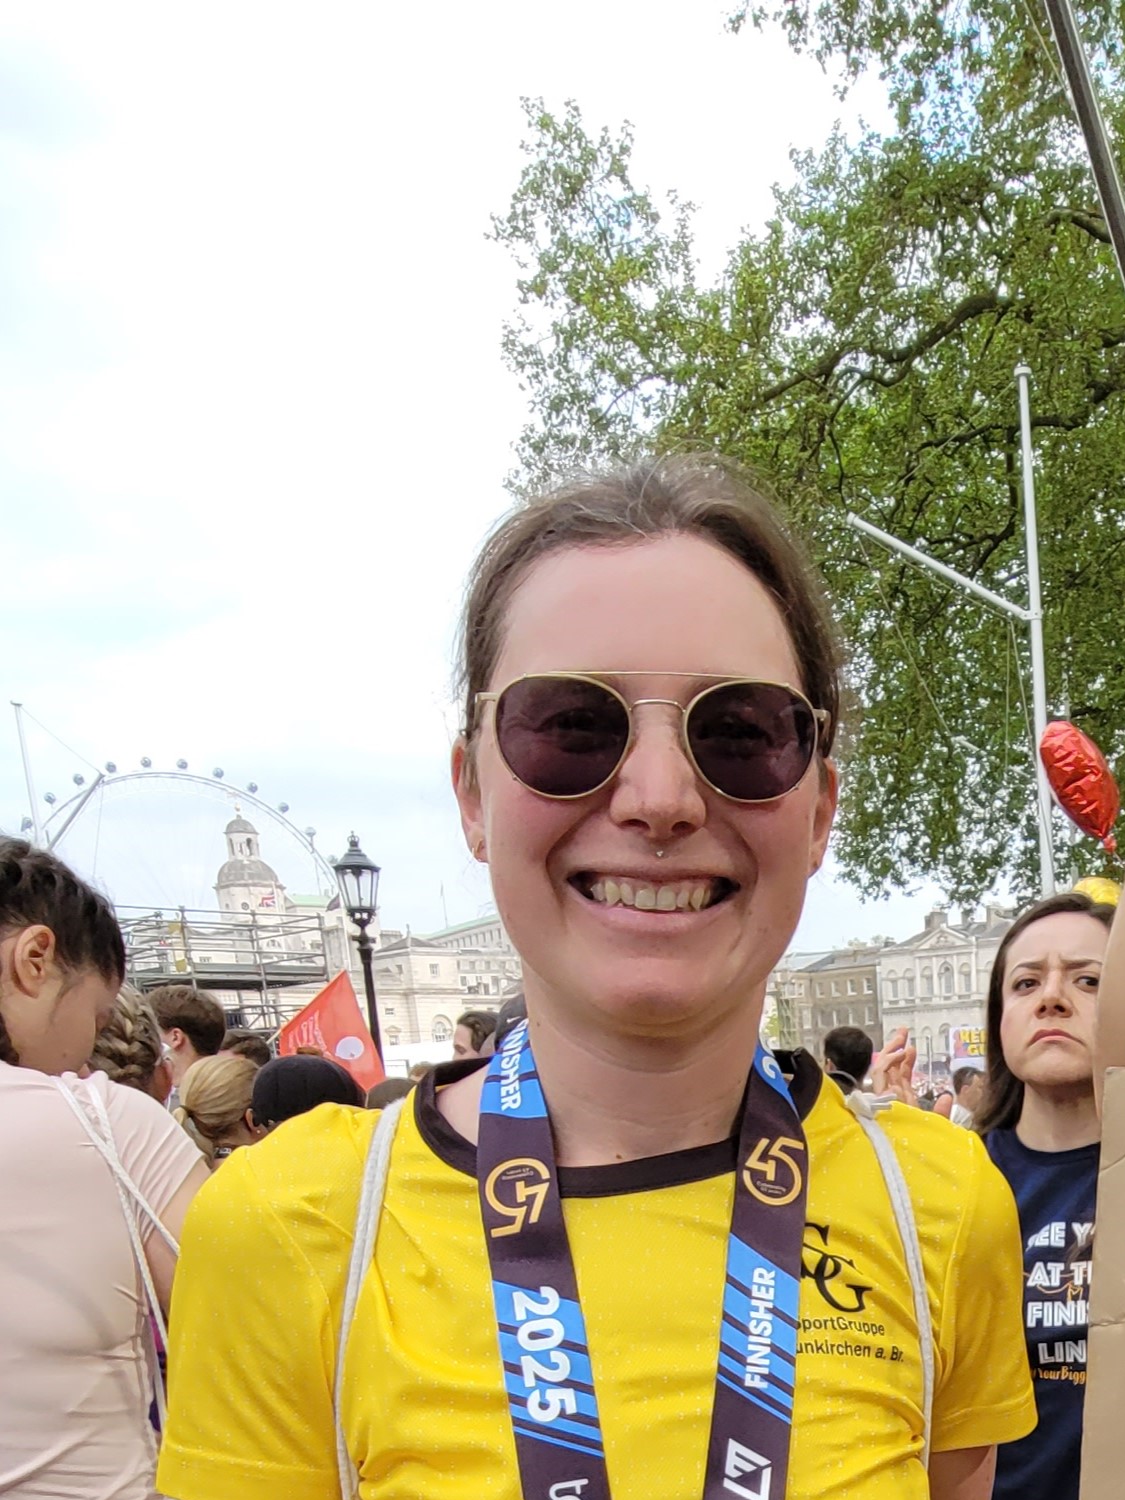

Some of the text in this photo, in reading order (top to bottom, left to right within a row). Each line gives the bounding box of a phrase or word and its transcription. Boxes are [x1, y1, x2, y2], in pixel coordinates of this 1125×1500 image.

[1026, 1261, 1065, 1287] AT
[744, 1267, 775, 1389] FINISHER
[1026, 1300, 1090, 1328] FINI
[511, 1286, 577, 1423] 2025
